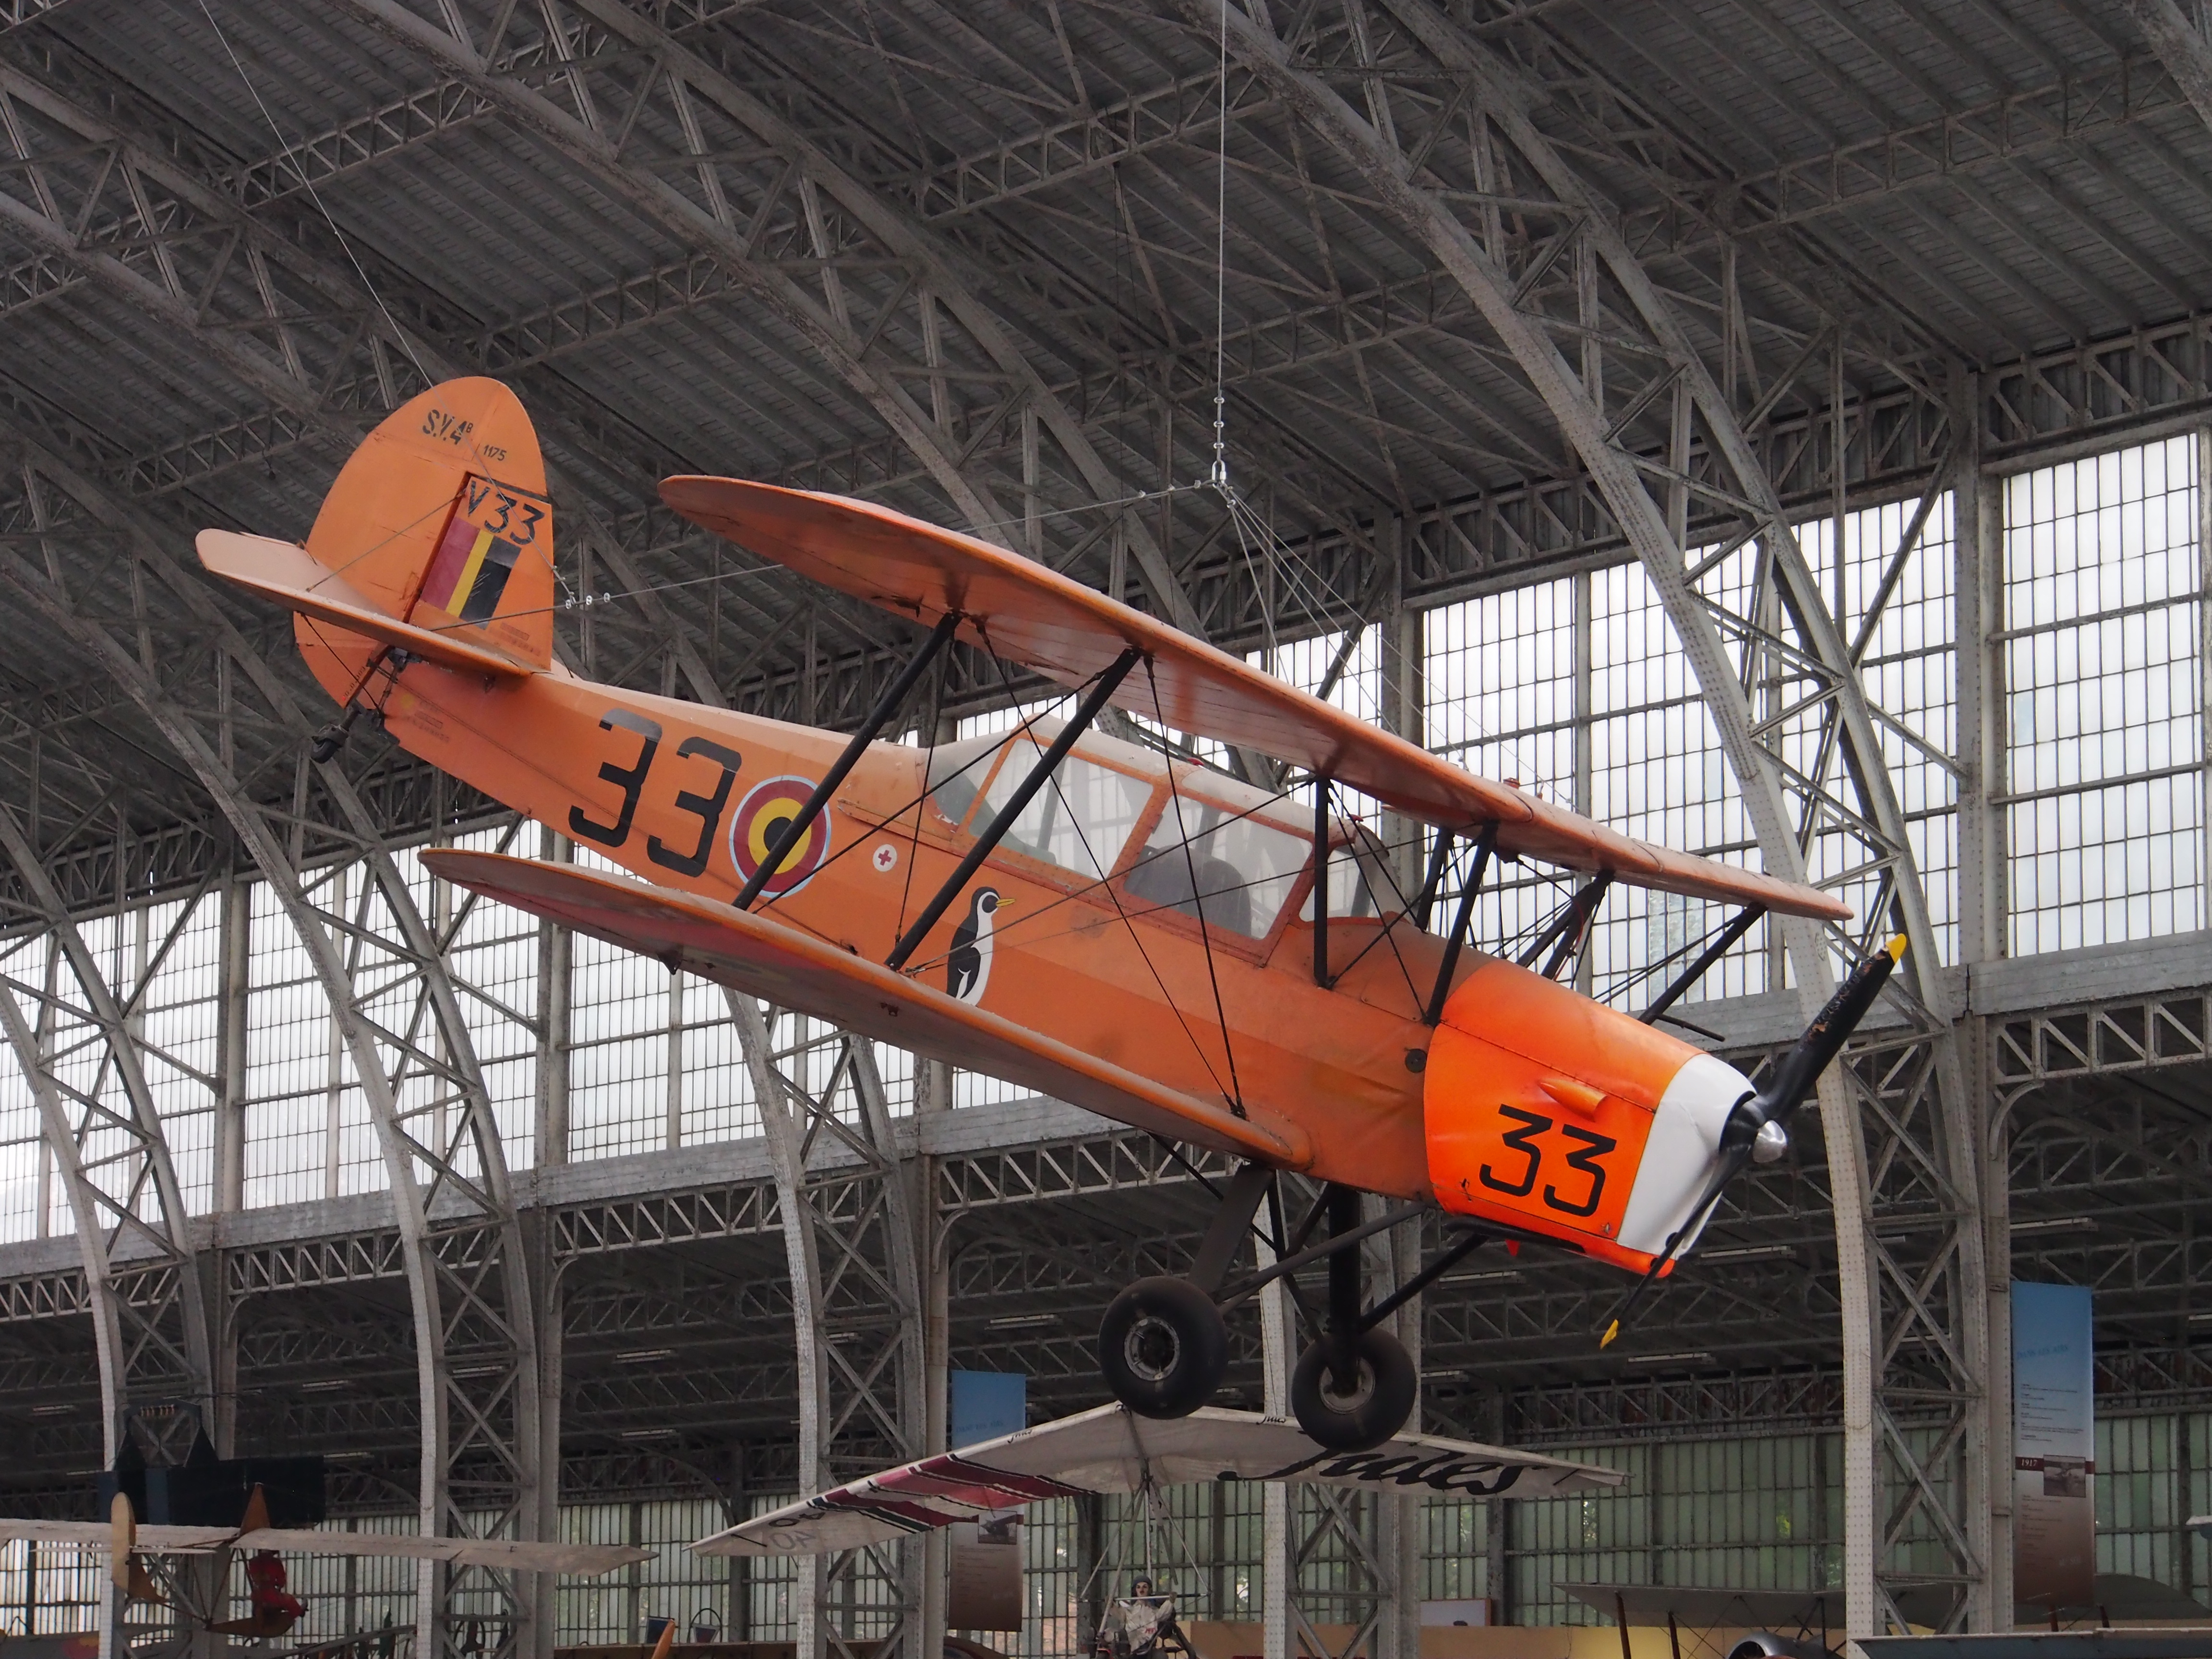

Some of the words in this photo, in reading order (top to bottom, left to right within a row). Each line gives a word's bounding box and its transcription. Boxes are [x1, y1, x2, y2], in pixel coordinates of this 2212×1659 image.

[483, 445, 507, 461] 1175
[568, 708, 742, 878] 33
[1479, 1104, 1617, 1217] 33
[2021, 1458, 2038, 1467] 1917
